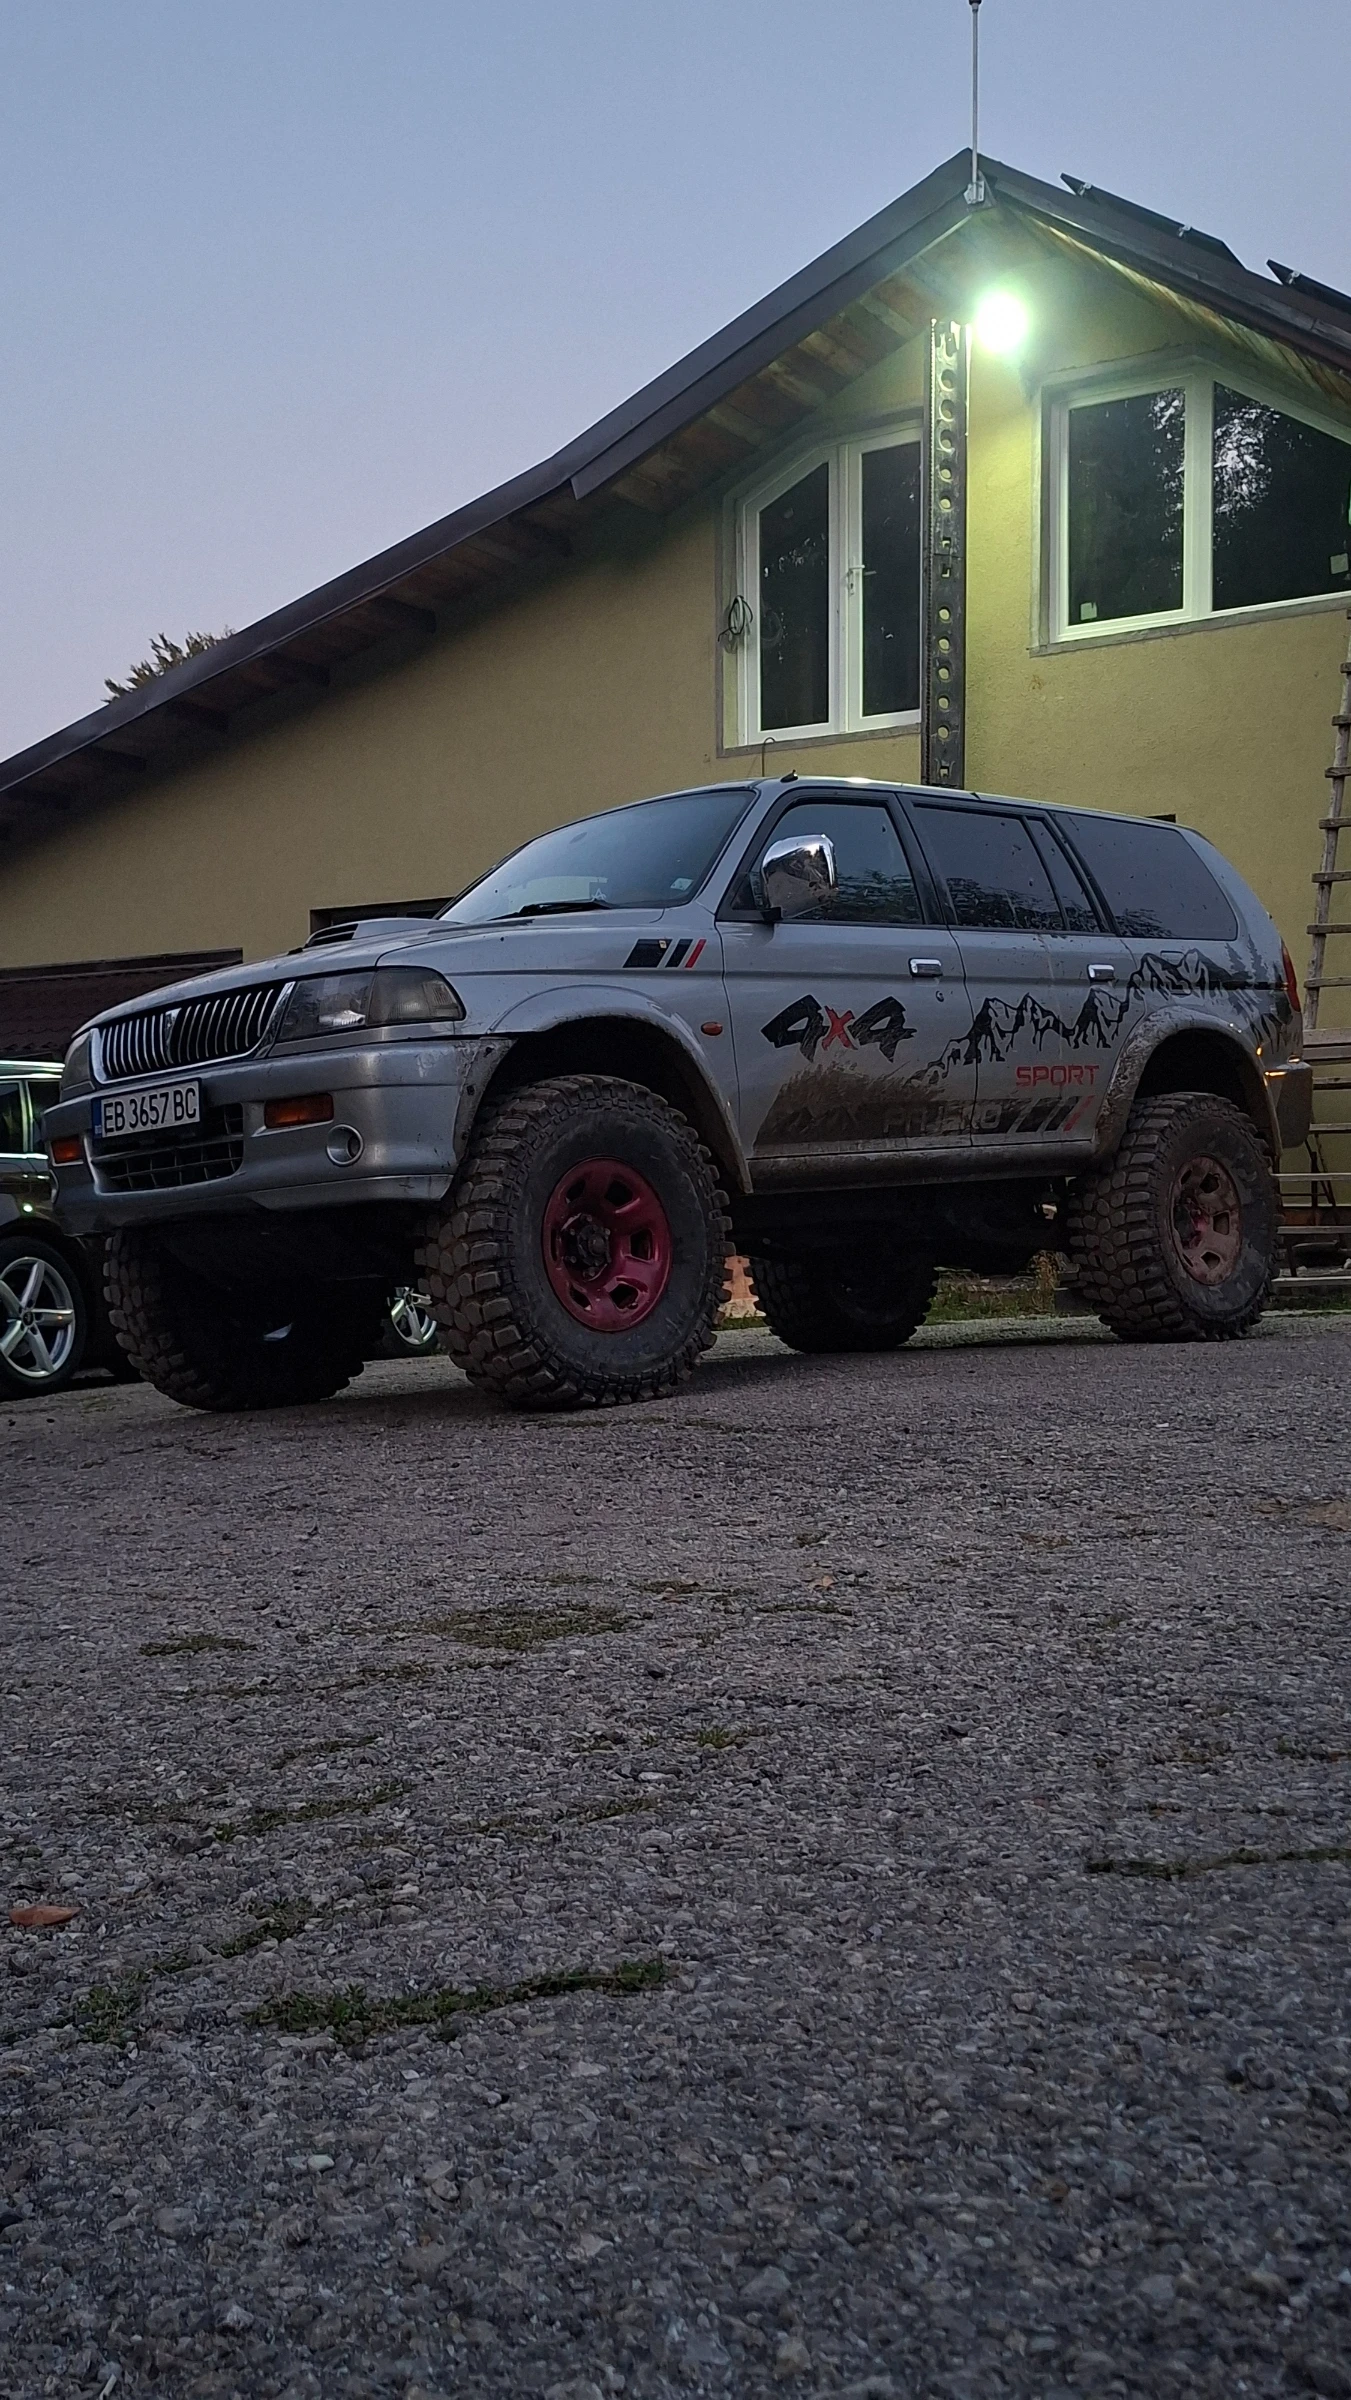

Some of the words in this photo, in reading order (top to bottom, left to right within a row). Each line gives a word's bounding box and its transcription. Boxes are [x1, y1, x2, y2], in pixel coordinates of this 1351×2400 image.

[1016, 1065, 1099, 1087] SPORT
[103, 1101, 125, 1134] EB
[129, 1092, 170, 1129] 3657
[173, 1087, 197, 1121] BC
